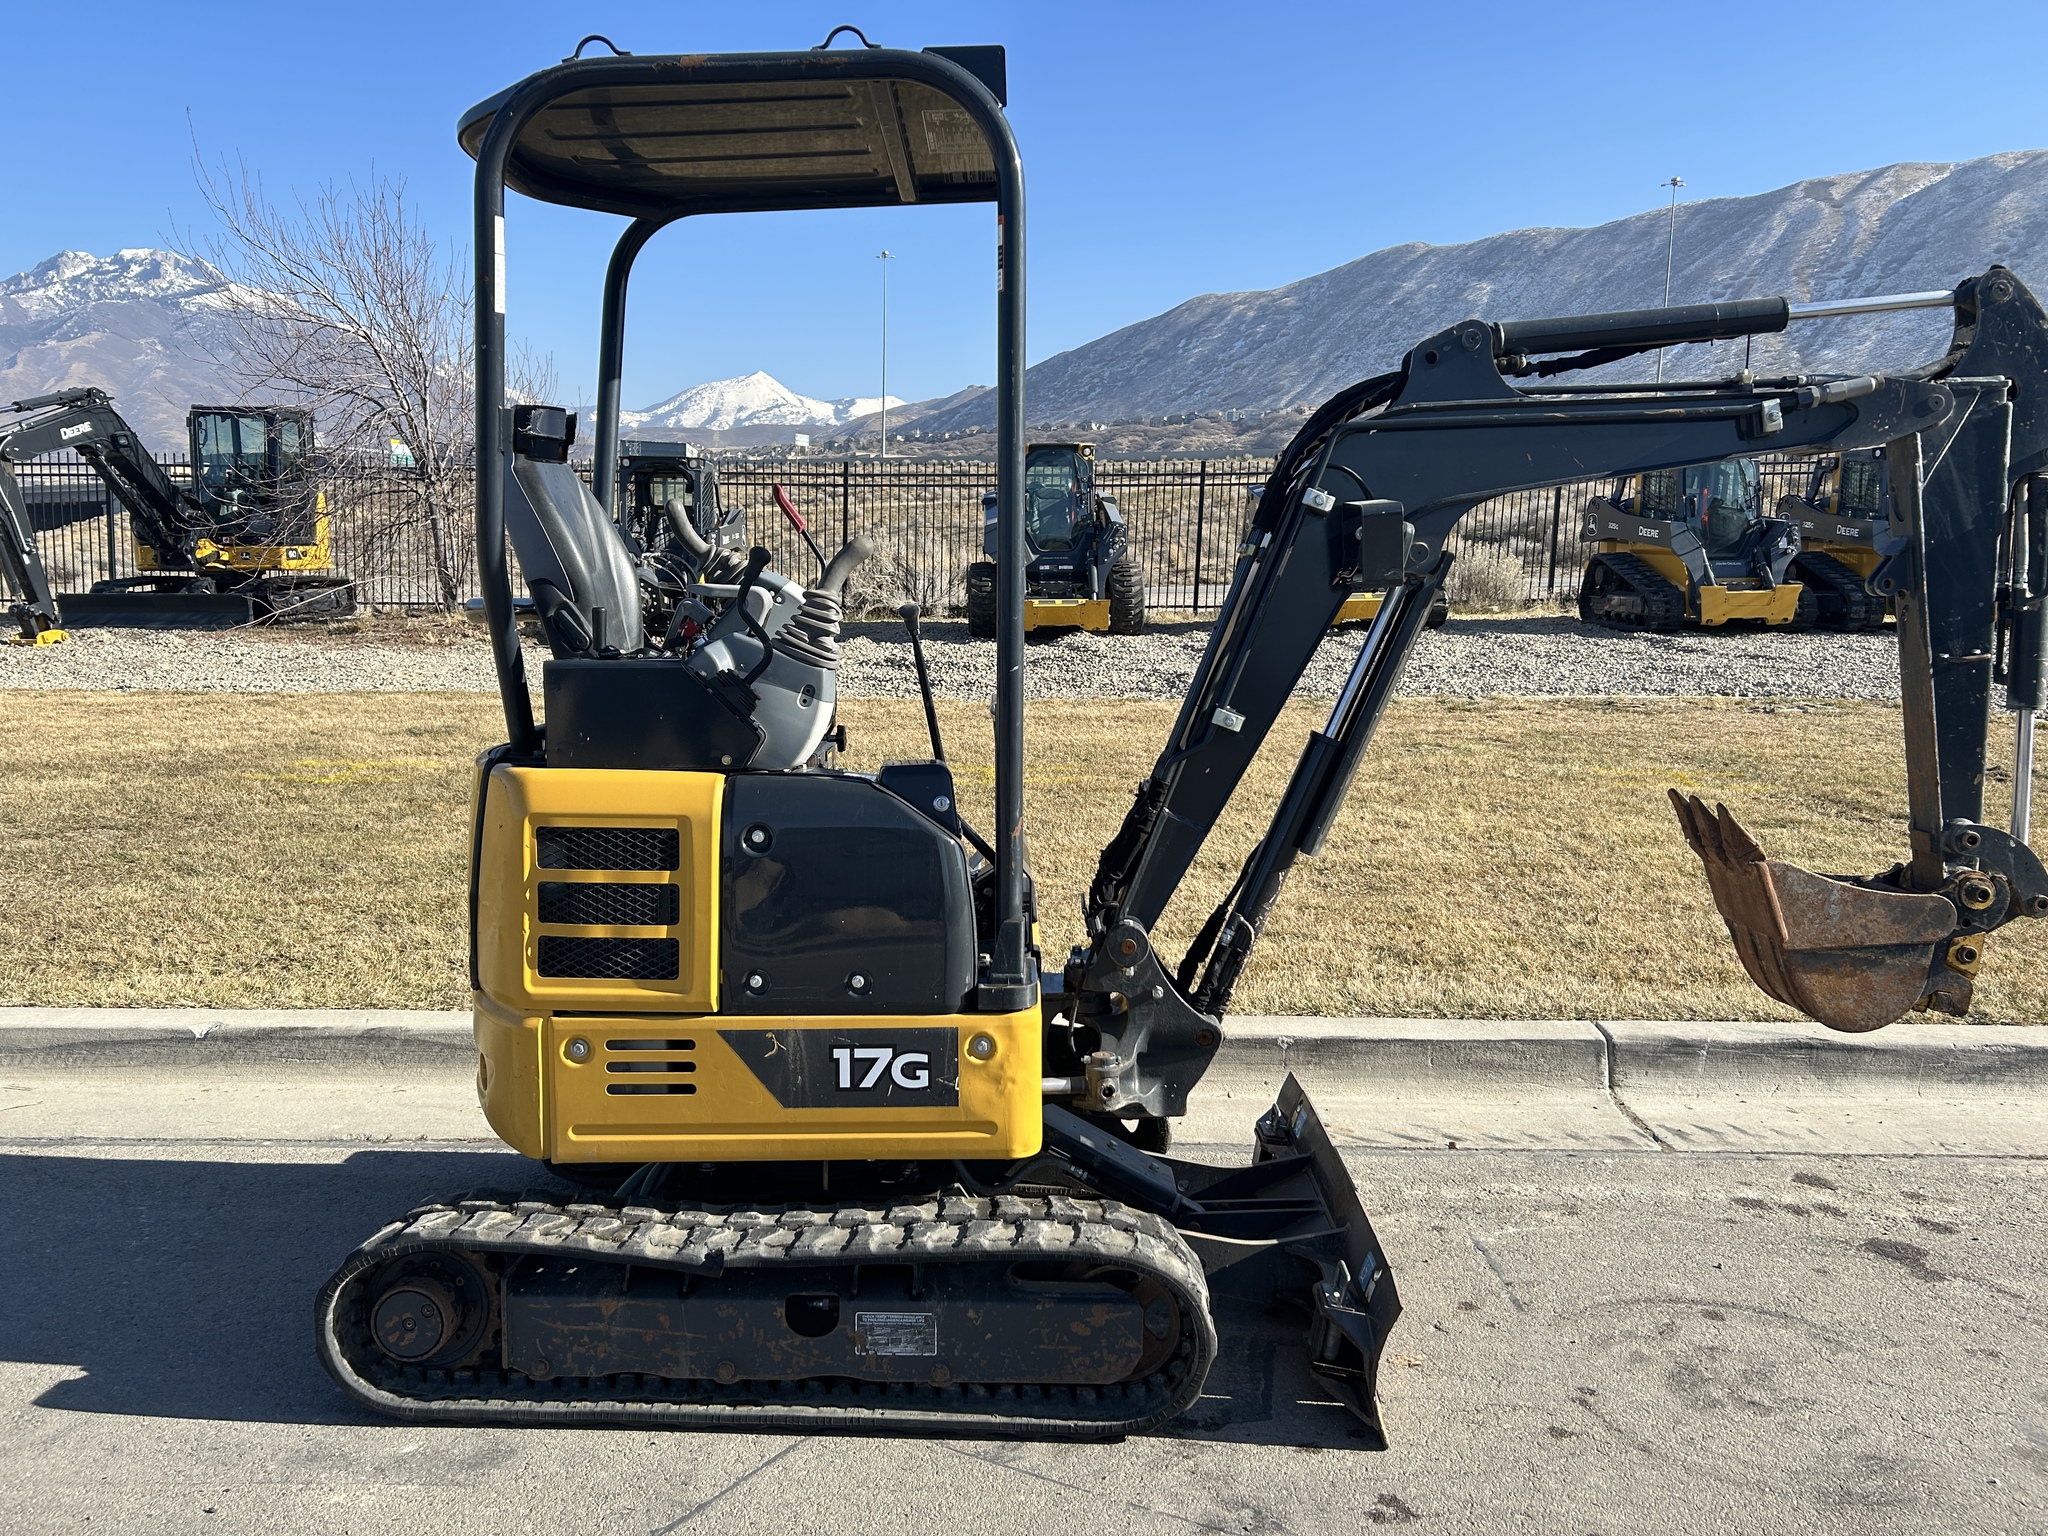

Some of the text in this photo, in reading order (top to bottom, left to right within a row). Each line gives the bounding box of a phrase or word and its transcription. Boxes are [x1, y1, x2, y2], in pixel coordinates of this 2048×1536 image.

[60, 421, 92, 440] DEERE
[1638, 526, 1659, 538] DEERE
[1836, 525, 1860, 537] DEERE
[833, 1048, 929, 1089] 17G
